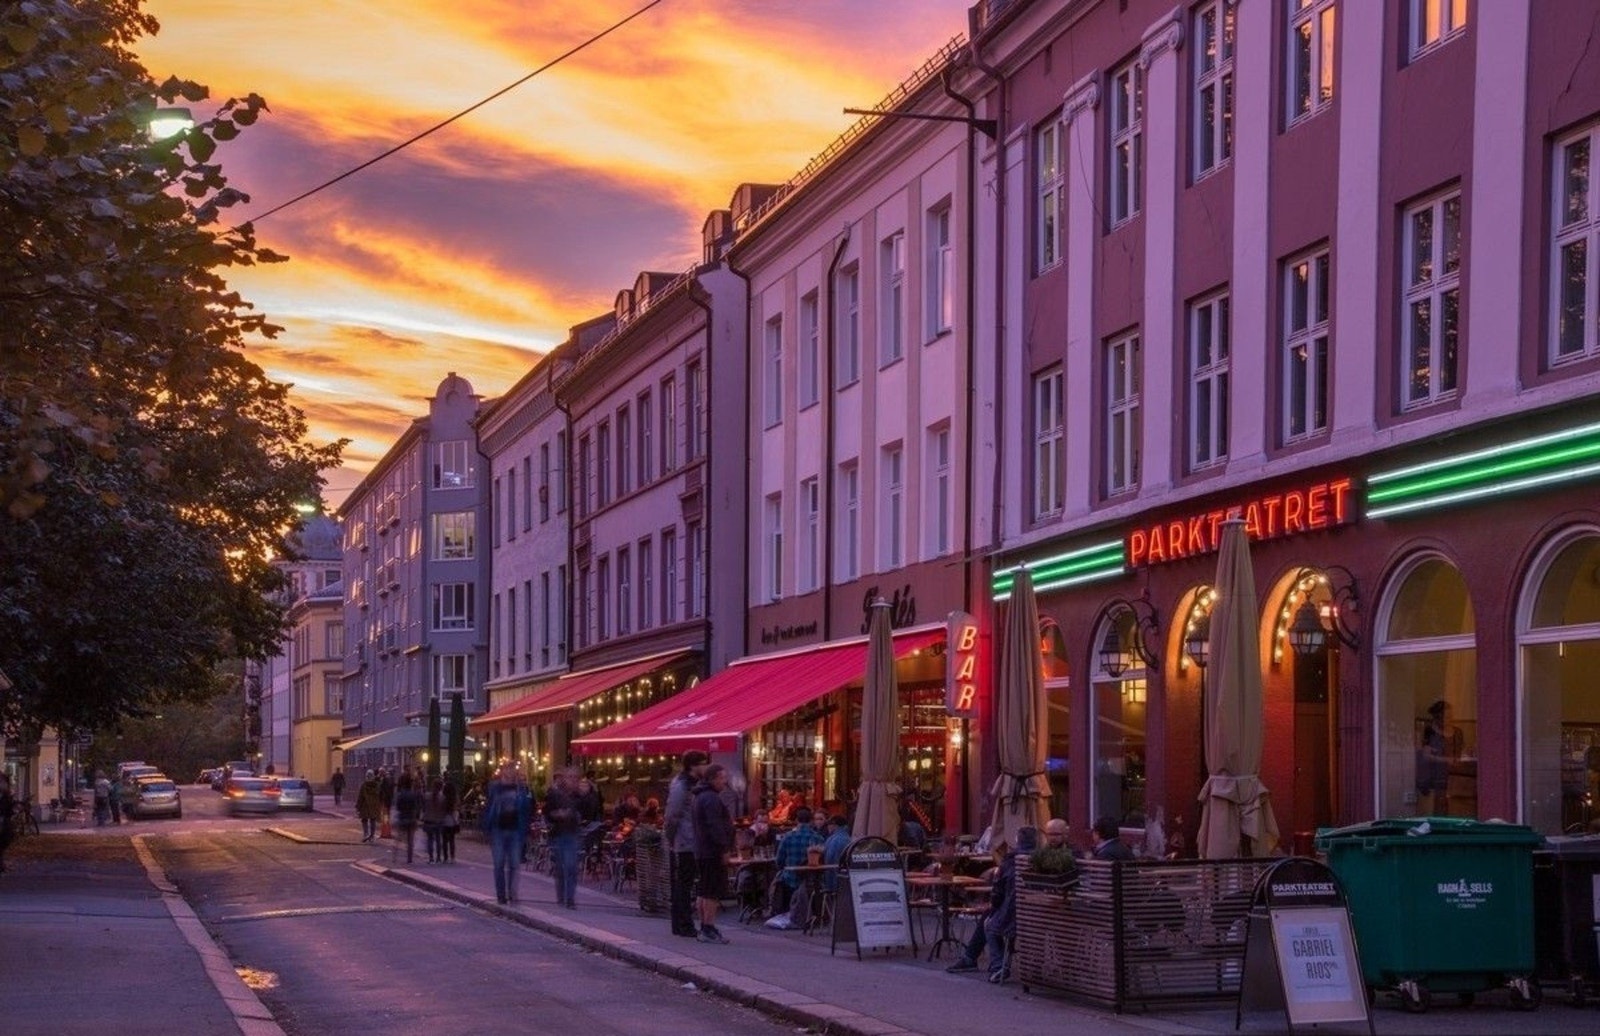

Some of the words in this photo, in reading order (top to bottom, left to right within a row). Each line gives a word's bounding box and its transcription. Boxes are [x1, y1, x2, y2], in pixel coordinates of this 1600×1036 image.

[956, 626, 977, 709] BAR
[1272, 883, 1334, 892] PARKTEATRET
[1470, 883, 1492, 893] SELLS
[1292, 939, 1336, 957] GABRIEL
[1306, 961, 1331, 979] RIOS
